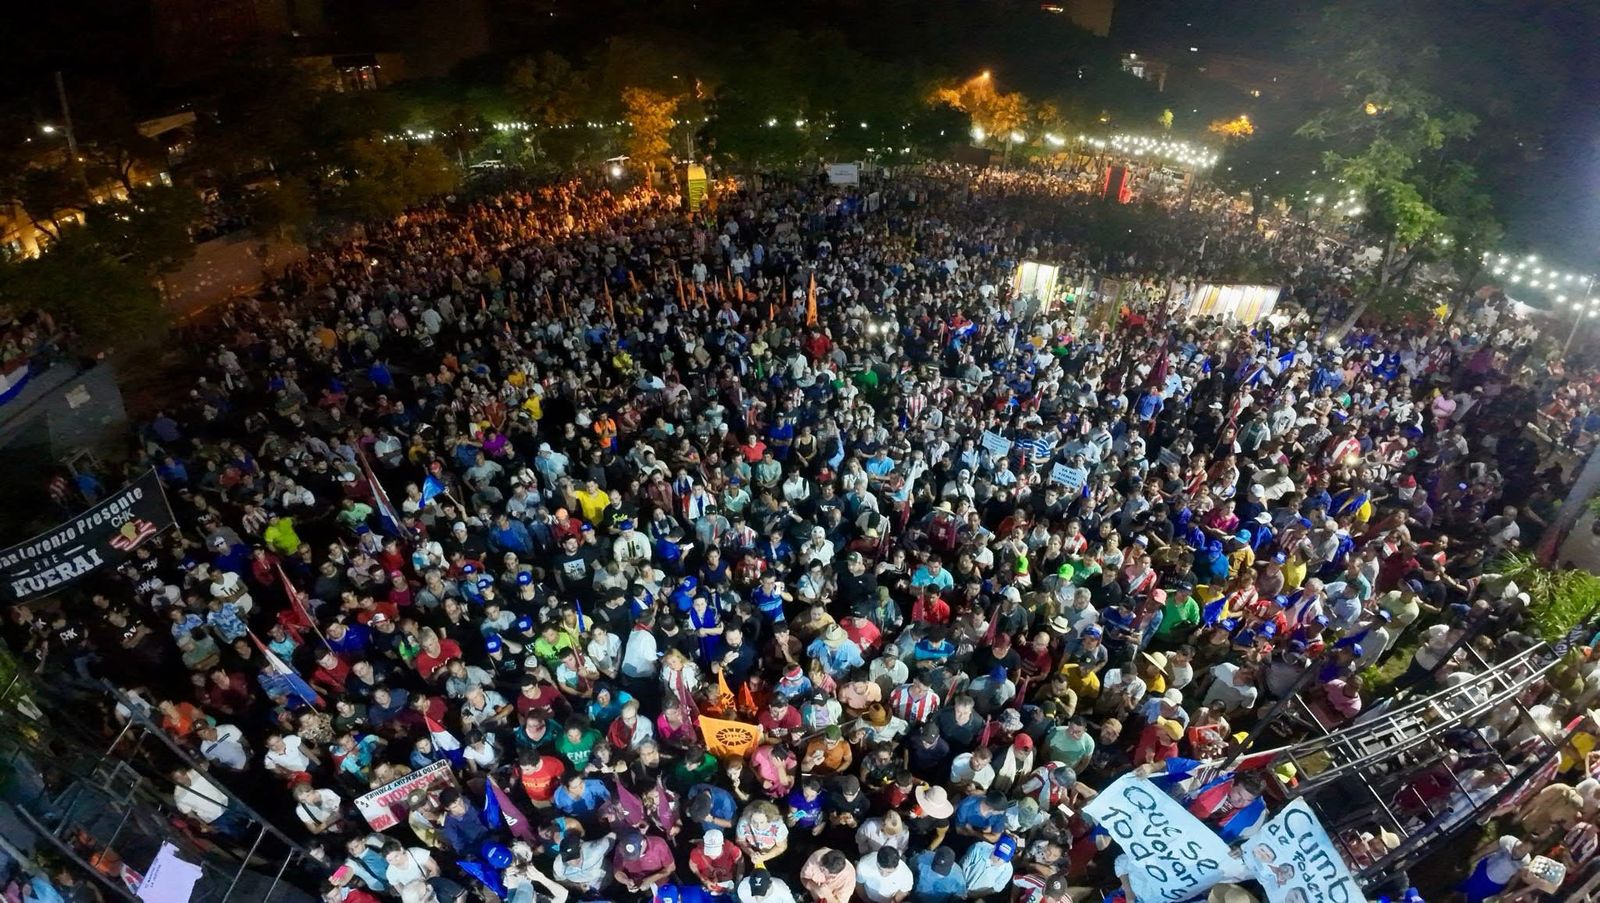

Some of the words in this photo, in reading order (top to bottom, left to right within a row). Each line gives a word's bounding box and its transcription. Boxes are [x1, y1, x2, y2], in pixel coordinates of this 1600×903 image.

[19, 528, 76, 560] Lorenzo
[77, 487, 143, 535] Presente
[111, 508, 135, 528] CHK
[11, 548, 104, 598] KUERAI
[34, 554, 59, 571] CHE
